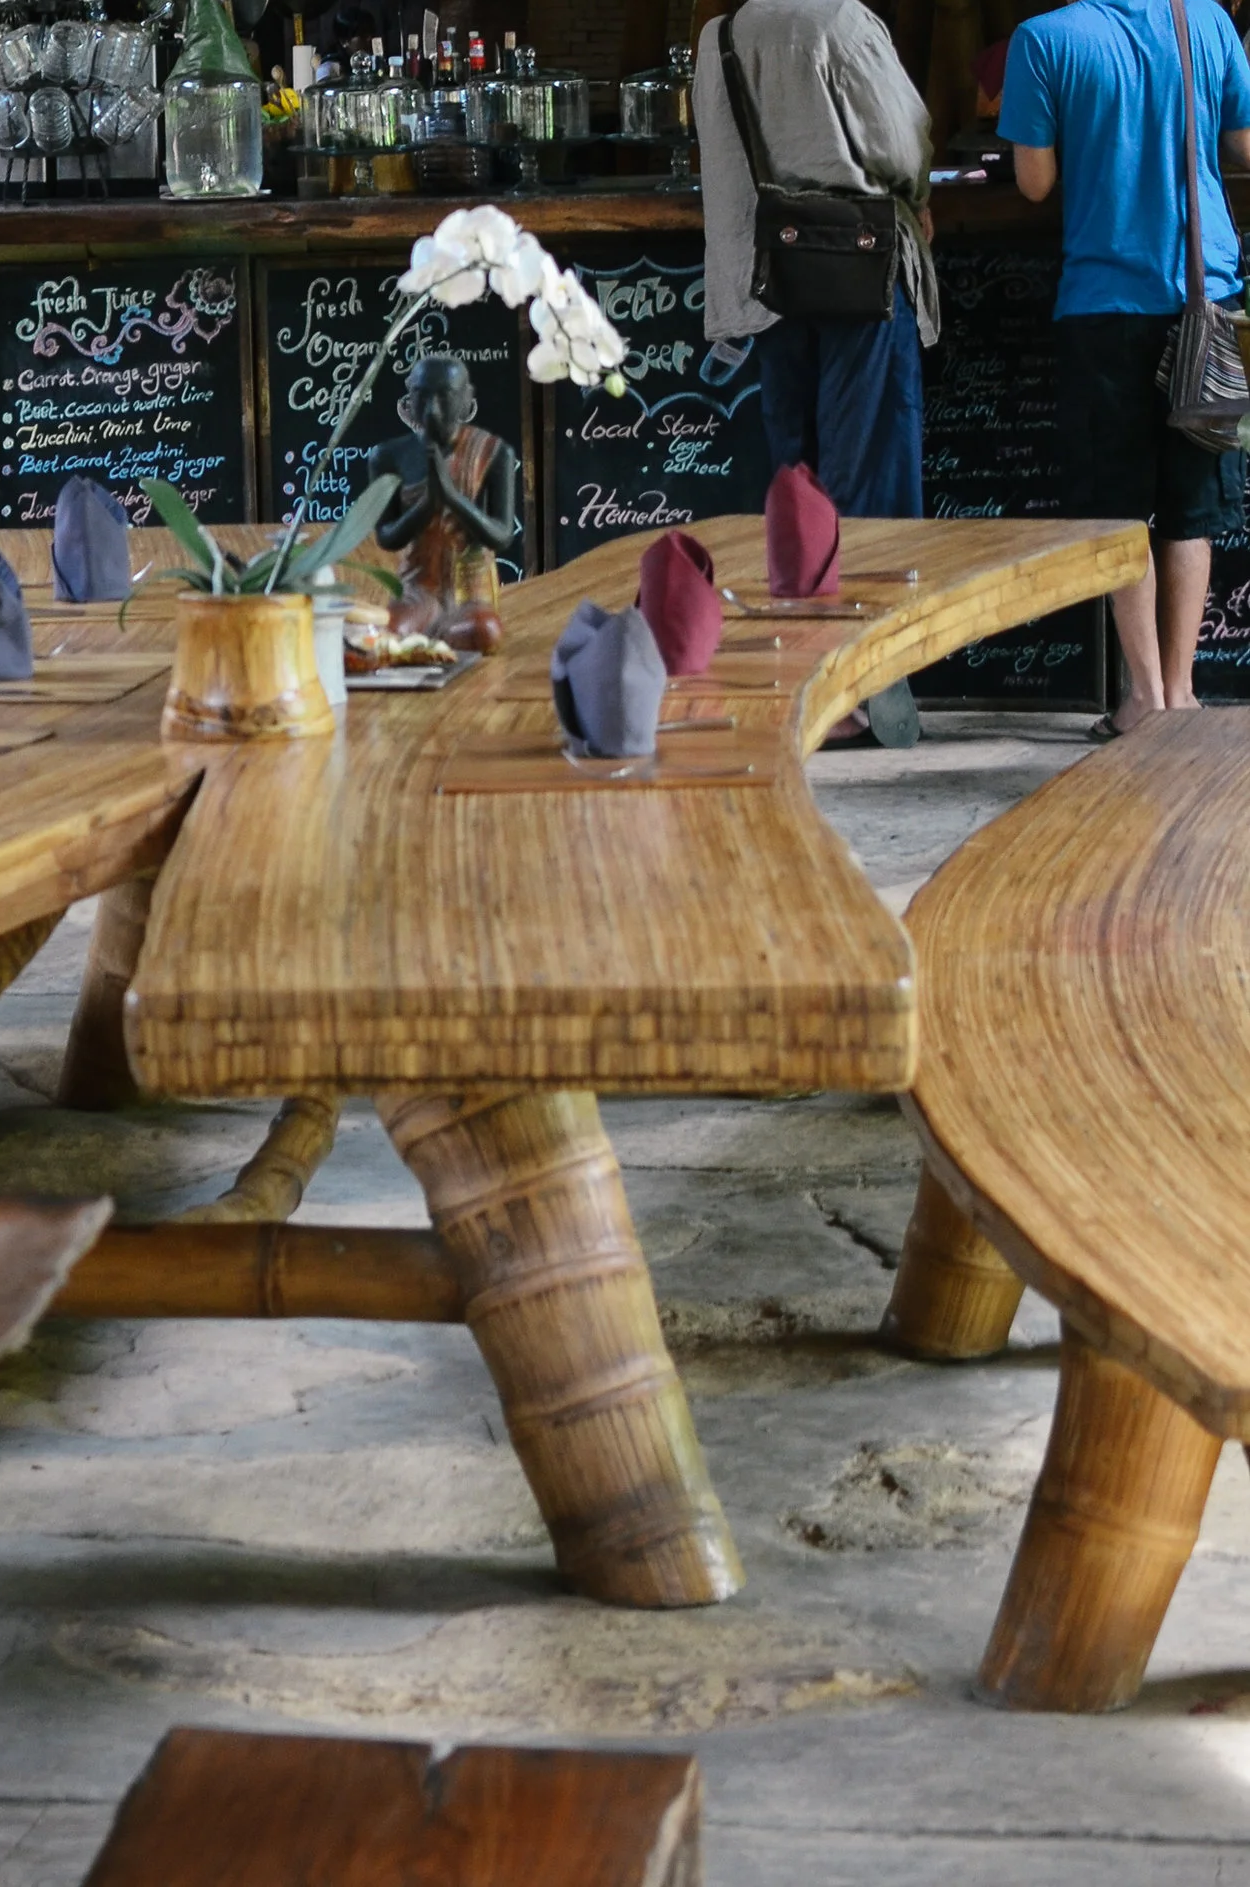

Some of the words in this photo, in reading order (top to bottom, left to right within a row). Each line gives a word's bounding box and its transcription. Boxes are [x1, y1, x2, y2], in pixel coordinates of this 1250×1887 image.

[70, 286, 157, 343] Juice
[140, 359, 203, 395] ginger
[656, 413, 721, 436] Stark
[576, 482, 693, 530] Heineken
